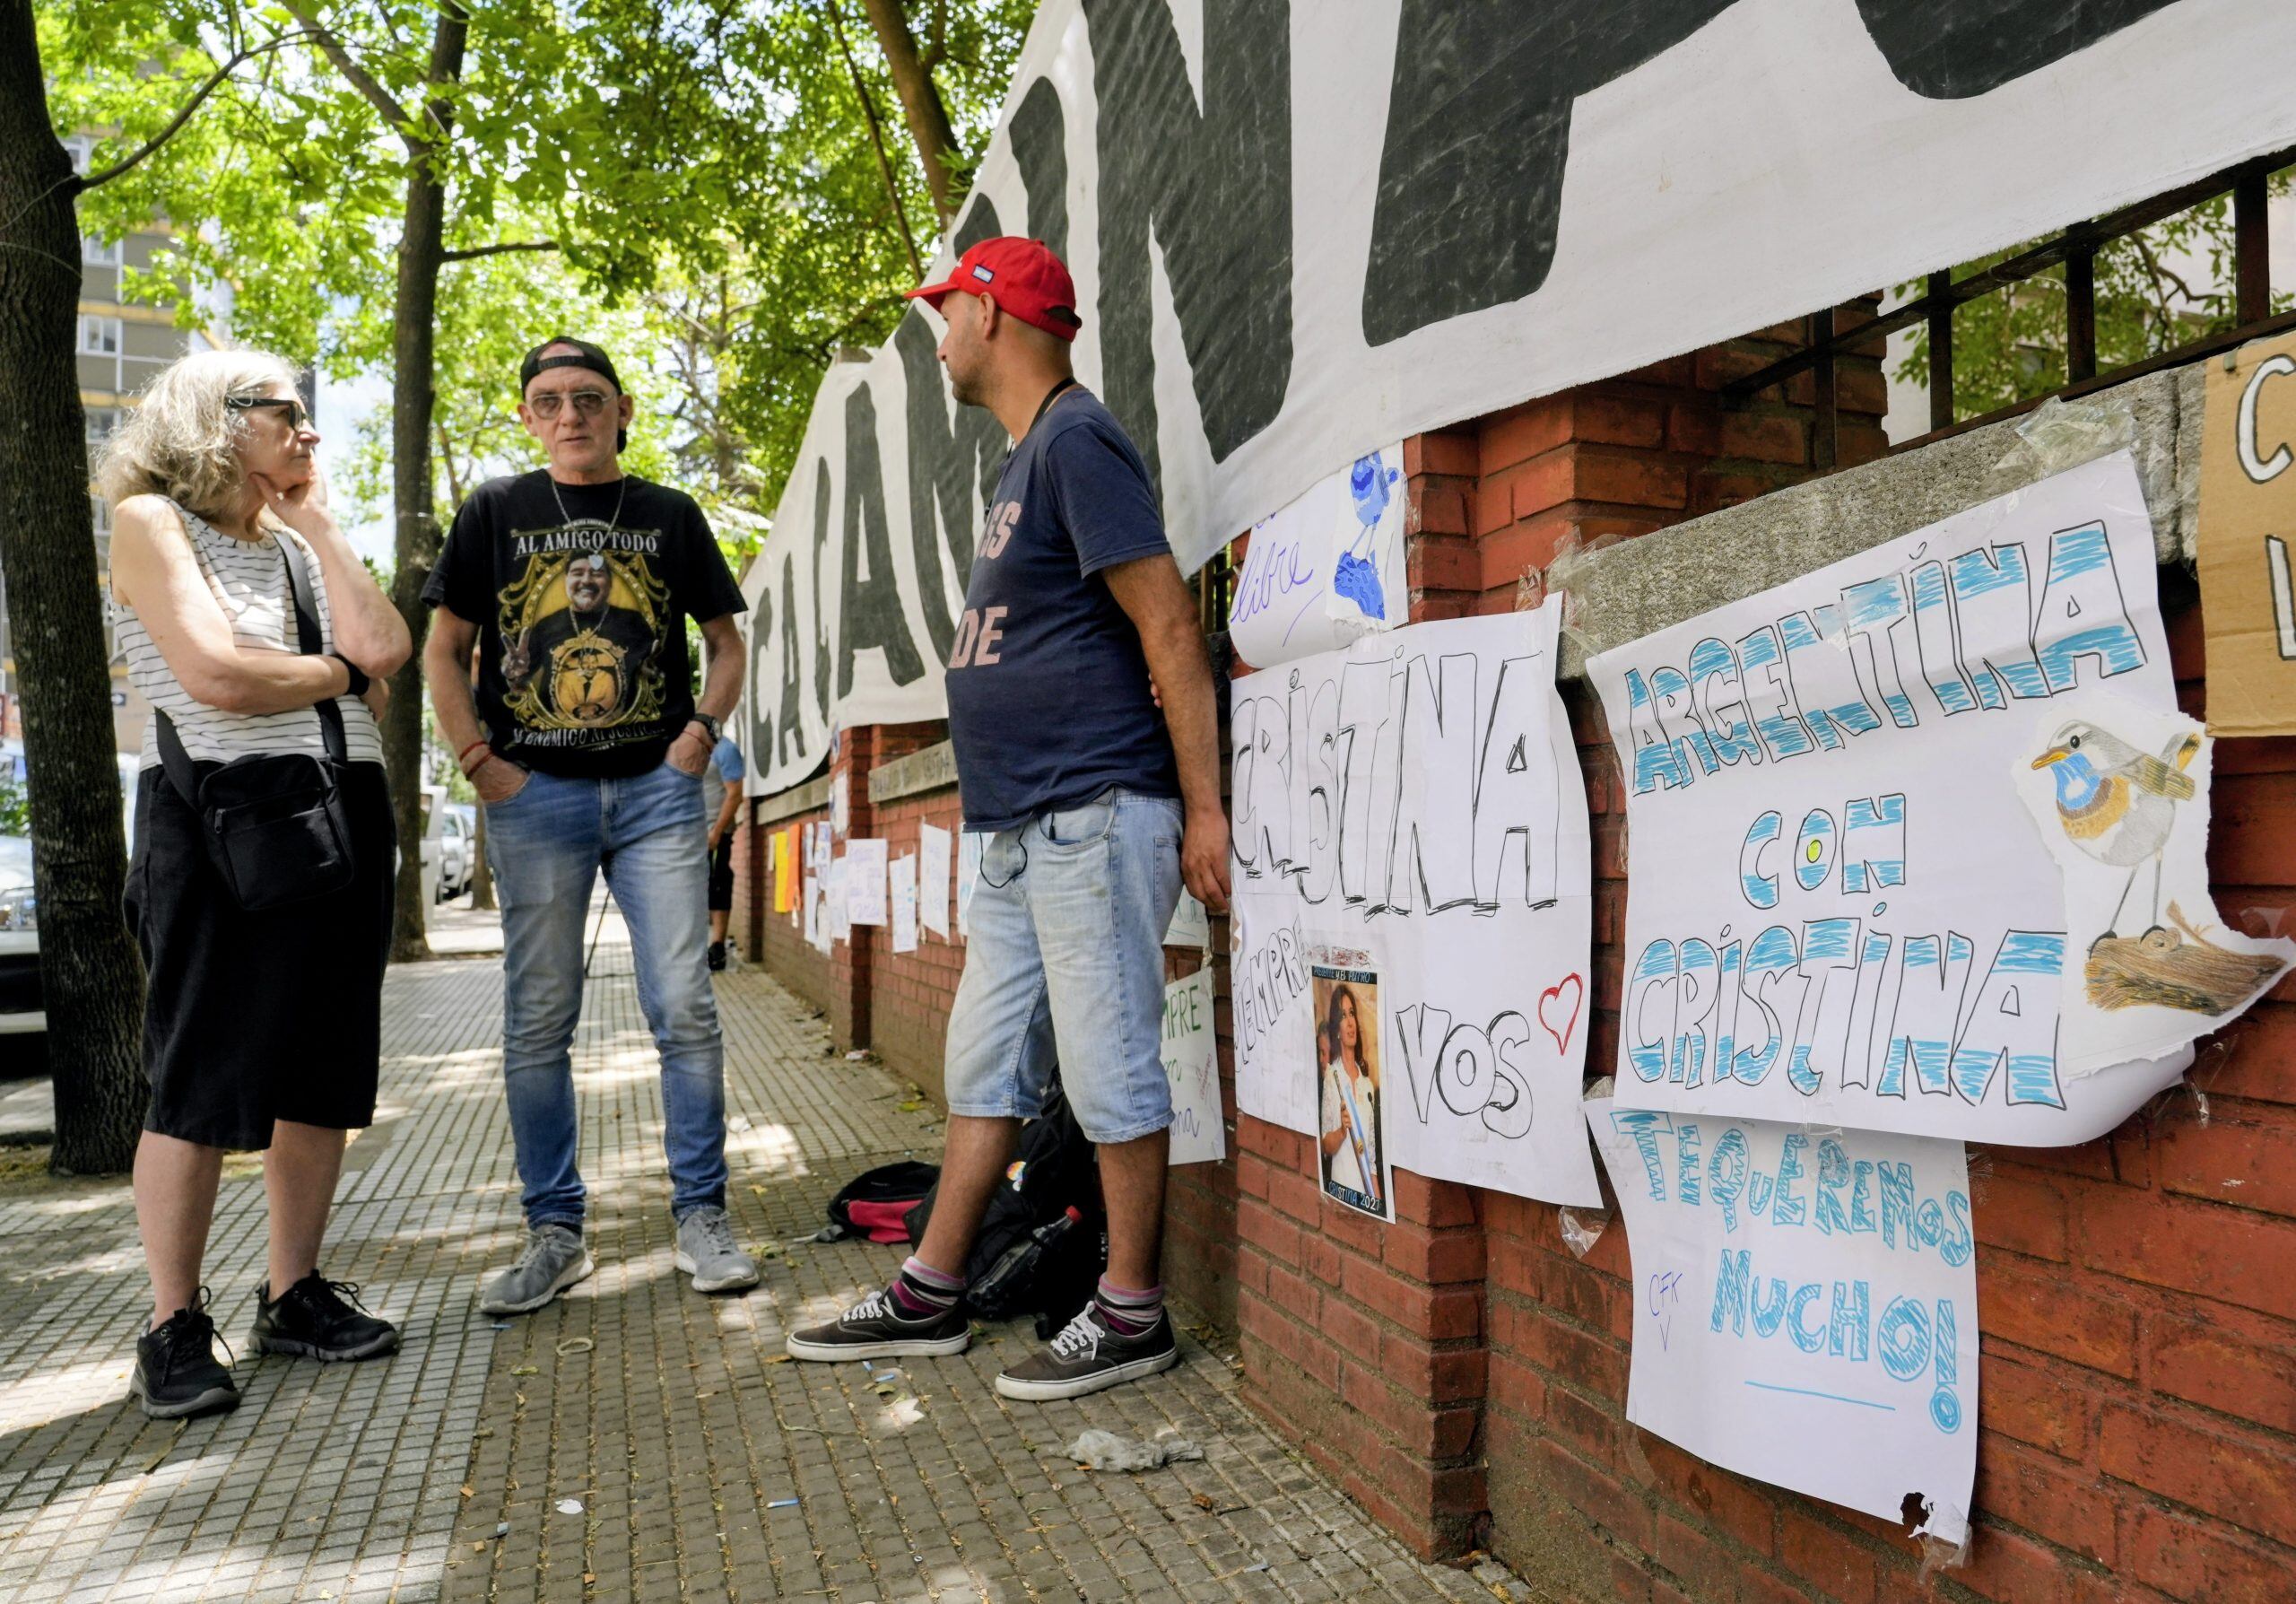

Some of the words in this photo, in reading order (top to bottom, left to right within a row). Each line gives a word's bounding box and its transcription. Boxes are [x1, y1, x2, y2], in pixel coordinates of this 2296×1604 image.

[516, 536, 538, 555] AL
[543, 530, 604, 553] AMIGO
[609, 531, 658, 554] TODO
[1740, 792, 1907, 910] CON
[1396, 1002, 1533, 1138] VOS
[1648, 1270, 1683, 1317] CFK
[1710, 1248, 1962, 1434] MUCHO!
